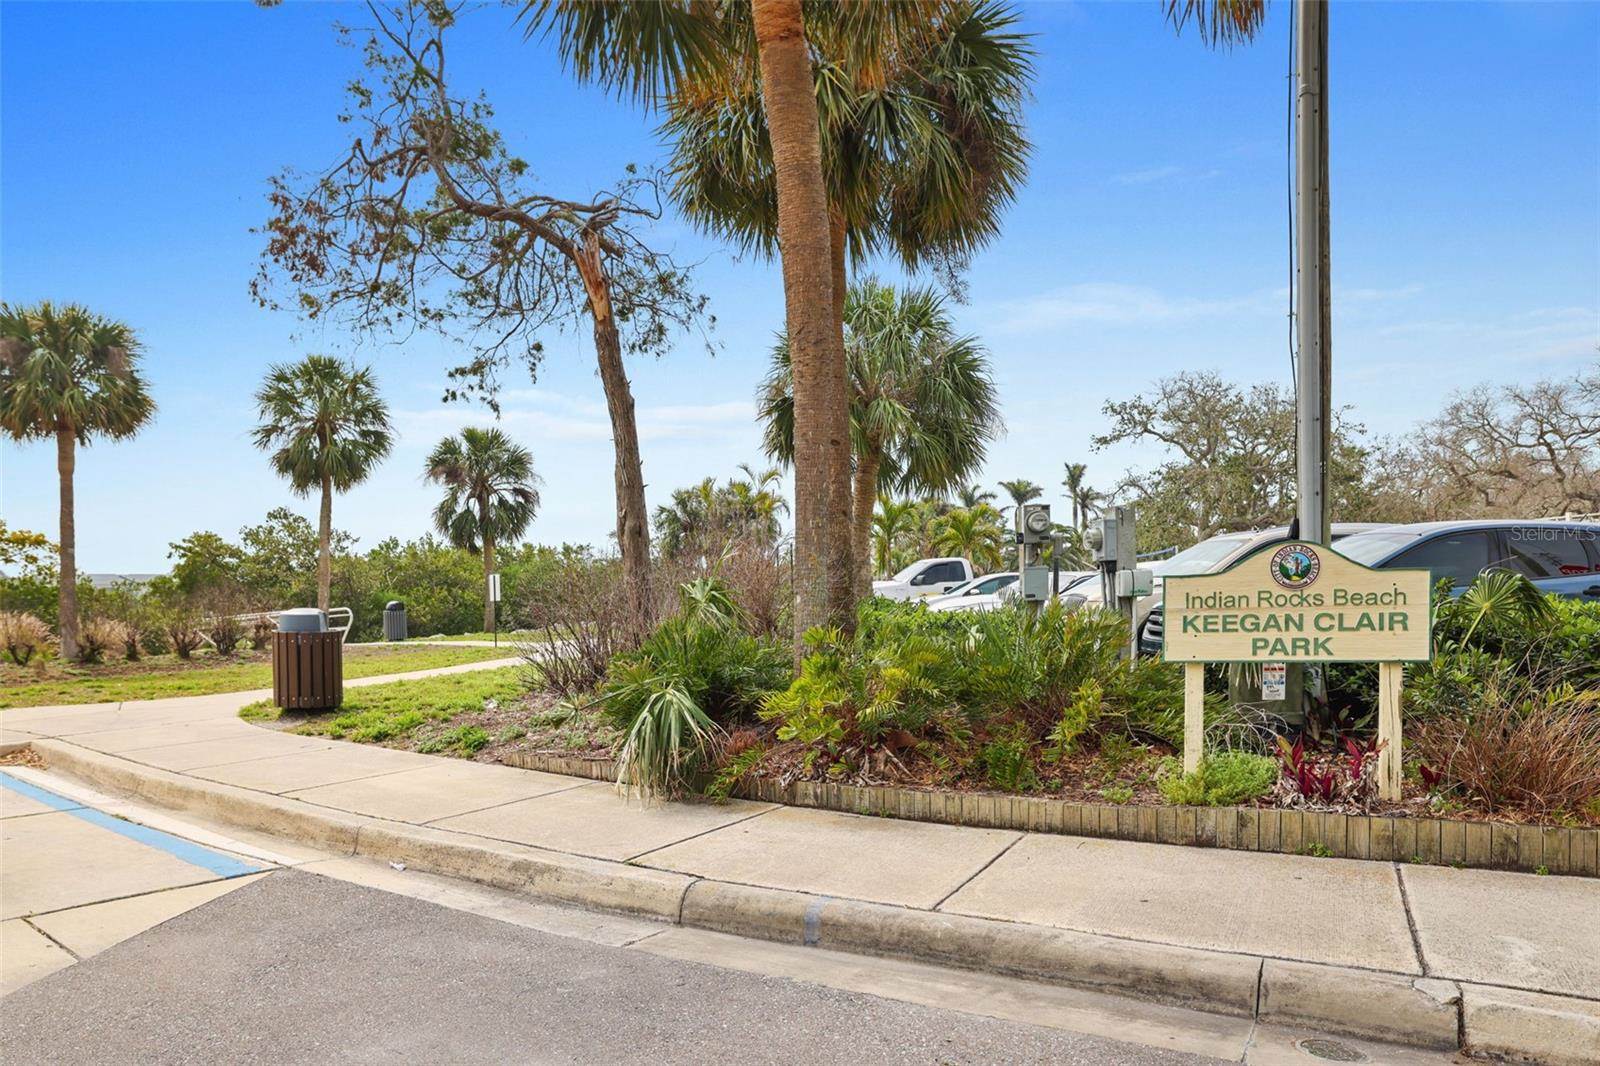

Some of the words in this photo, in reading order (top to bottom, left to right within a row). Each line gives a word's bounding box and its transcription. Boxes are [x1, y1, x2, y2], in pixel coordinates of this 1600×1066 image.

[1185, 591, 1250, 609] Indian
[1257, 588, 1324, 608] Rocks
[1333, 587, 1407, 606] Beach
[1182, 613, 1305, 633] KEEGAN
[1313, 611, 1409, 632] CLAIR
[1251, 637, 1334, 656] PARK
